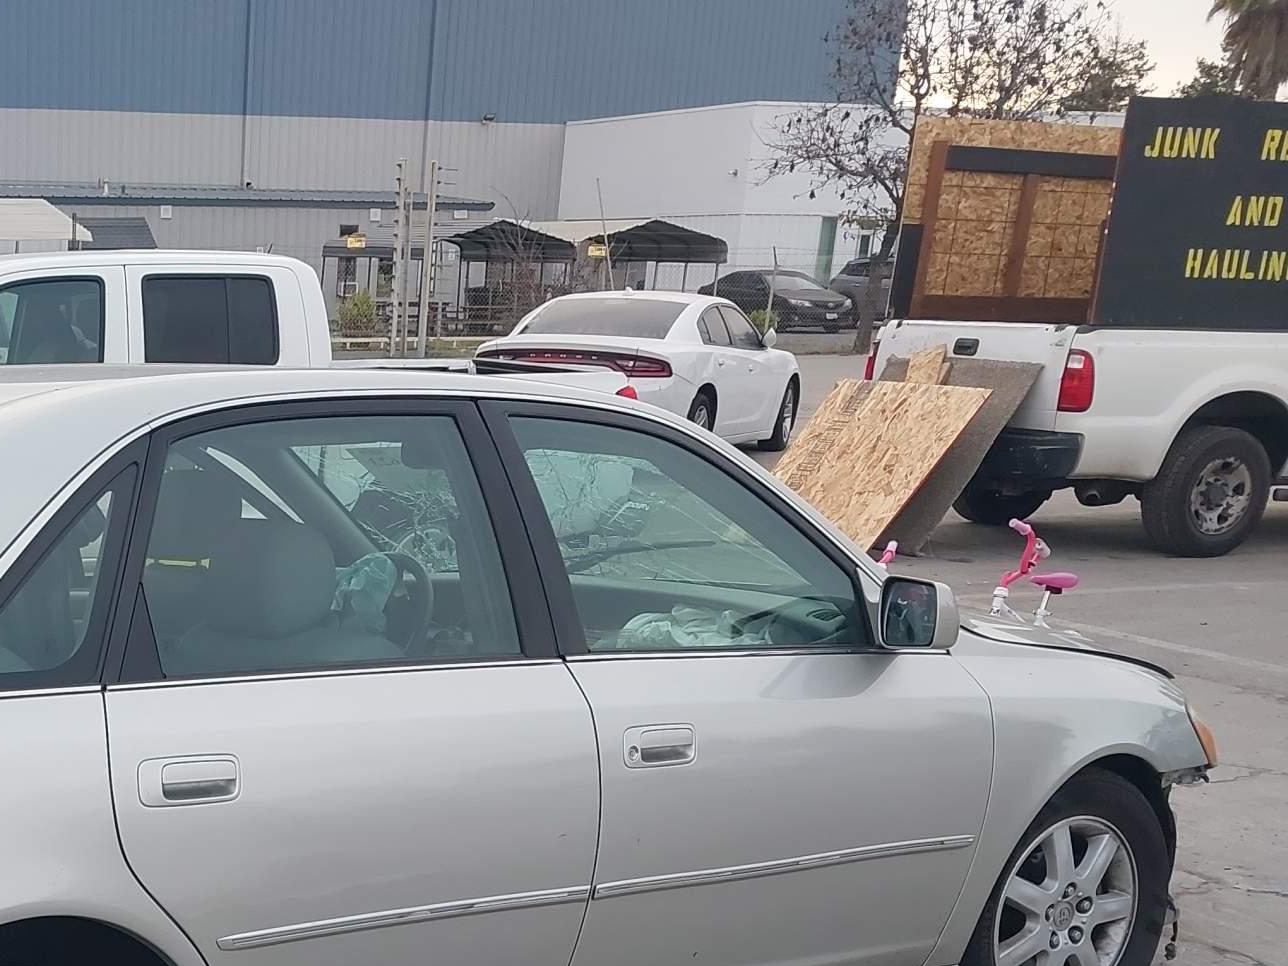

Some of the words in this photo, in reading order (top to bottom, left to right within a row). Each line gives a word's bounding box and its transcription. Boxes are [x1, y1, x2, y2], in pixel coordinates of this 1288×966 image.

[1144, 126, 1220, 159] JUNK
[1226, 196, 1284, 226] AND
[1185, 248, 1288, 281] HAULIN
